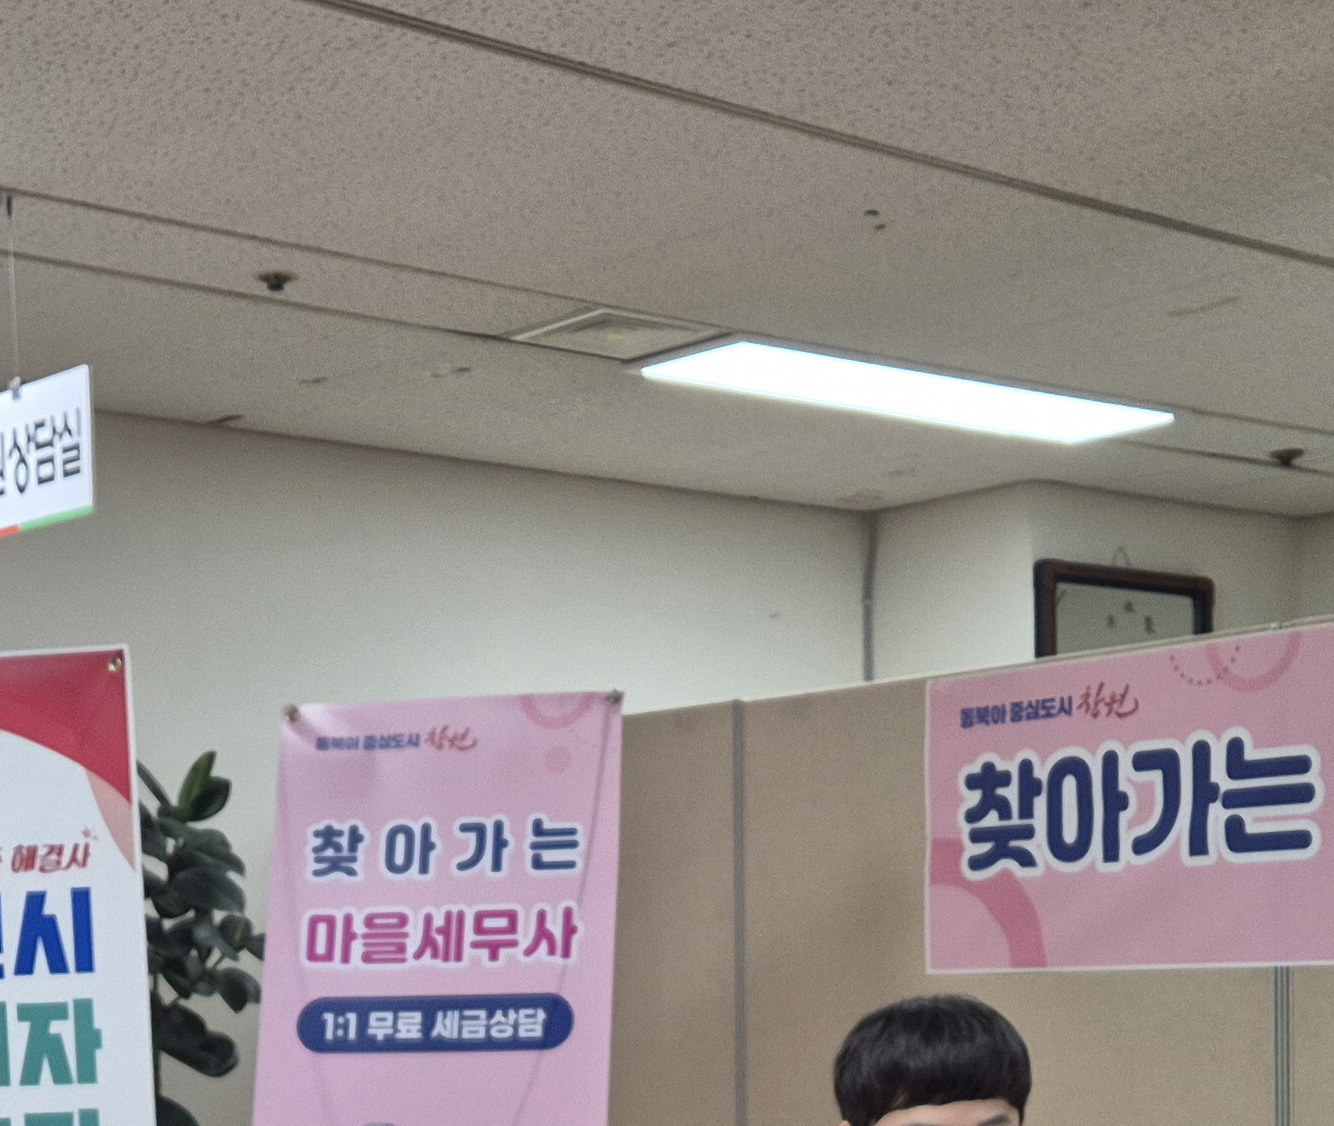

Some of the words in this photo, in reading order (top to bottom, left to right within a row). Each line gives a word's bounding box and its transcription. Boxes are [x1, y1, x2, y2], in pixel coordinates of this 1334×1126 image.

[960, 703, 1007, 729] 동북아
[1010, 695, 1074, 723] 중심도시
[963, 737, 1317, 873] 찾아가는
[11, 842, 91, 874] 해결사
[305, 906, 579, 965] 마을세무사
[322, 1011, 358, 1040] 1:1
[366, 1010, 423, 1041] 무료
[431, 1008, 547, 1040] 세금상담
